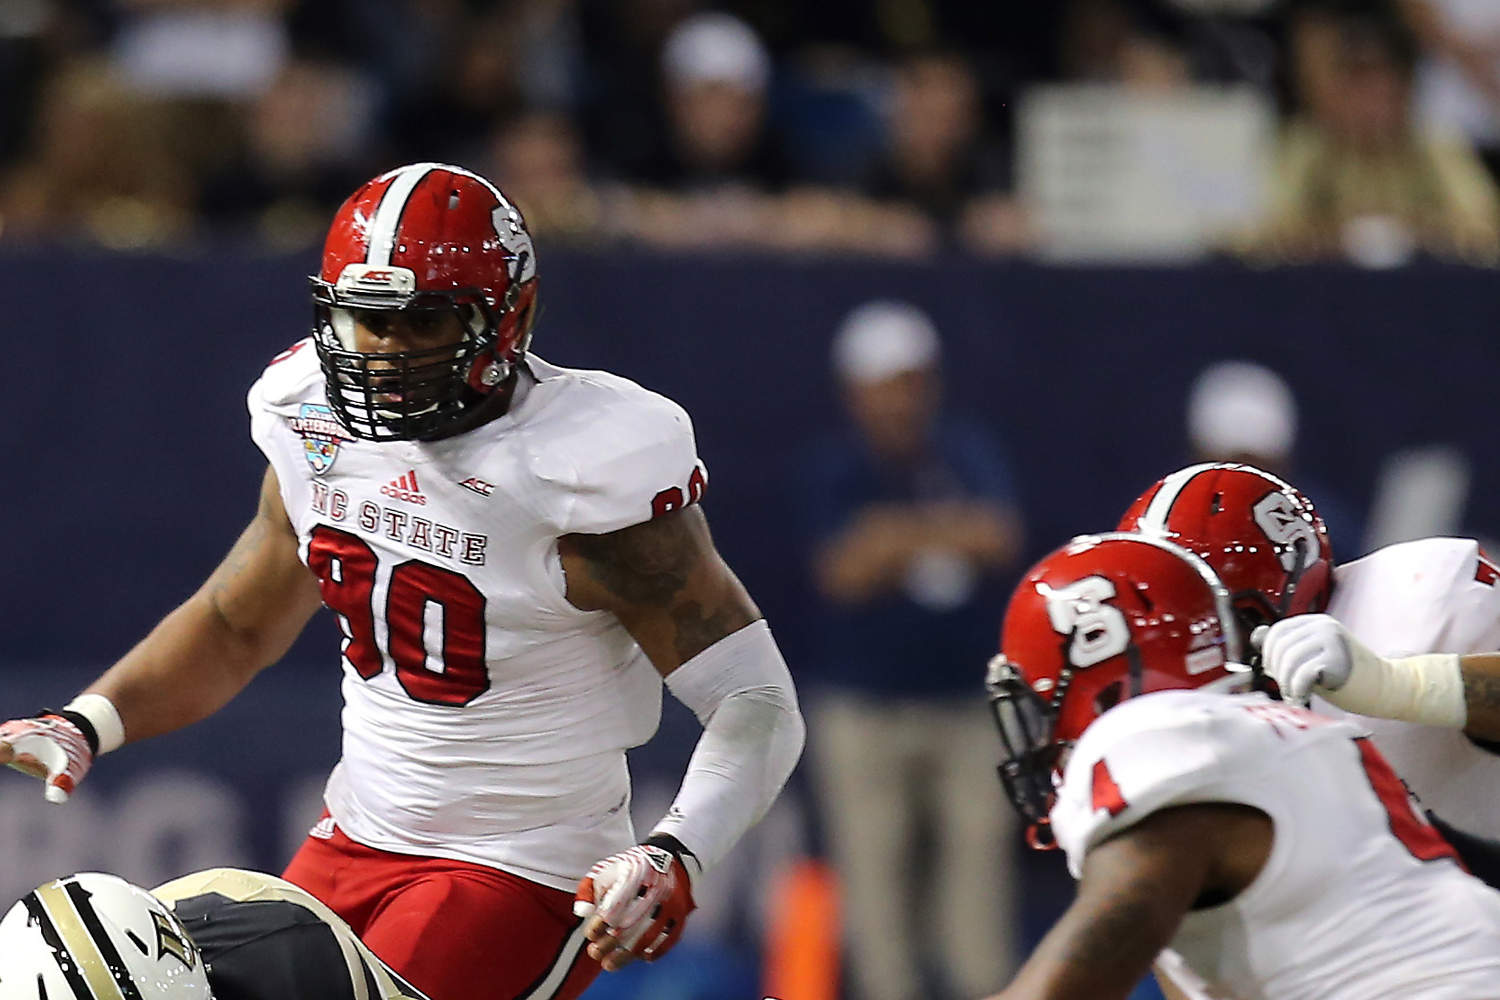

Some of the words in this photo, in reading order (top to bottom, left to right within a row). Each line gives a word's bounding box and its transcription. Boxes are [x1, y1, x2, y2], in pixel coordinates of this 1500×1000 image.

[379, 485, 427, 506] adidas
[460, 477, 497, 495] ACC
[311, 478, 349, 522] NC
[359, 500, 488, 566] STATE
[307, 523, 491, 708] 90
